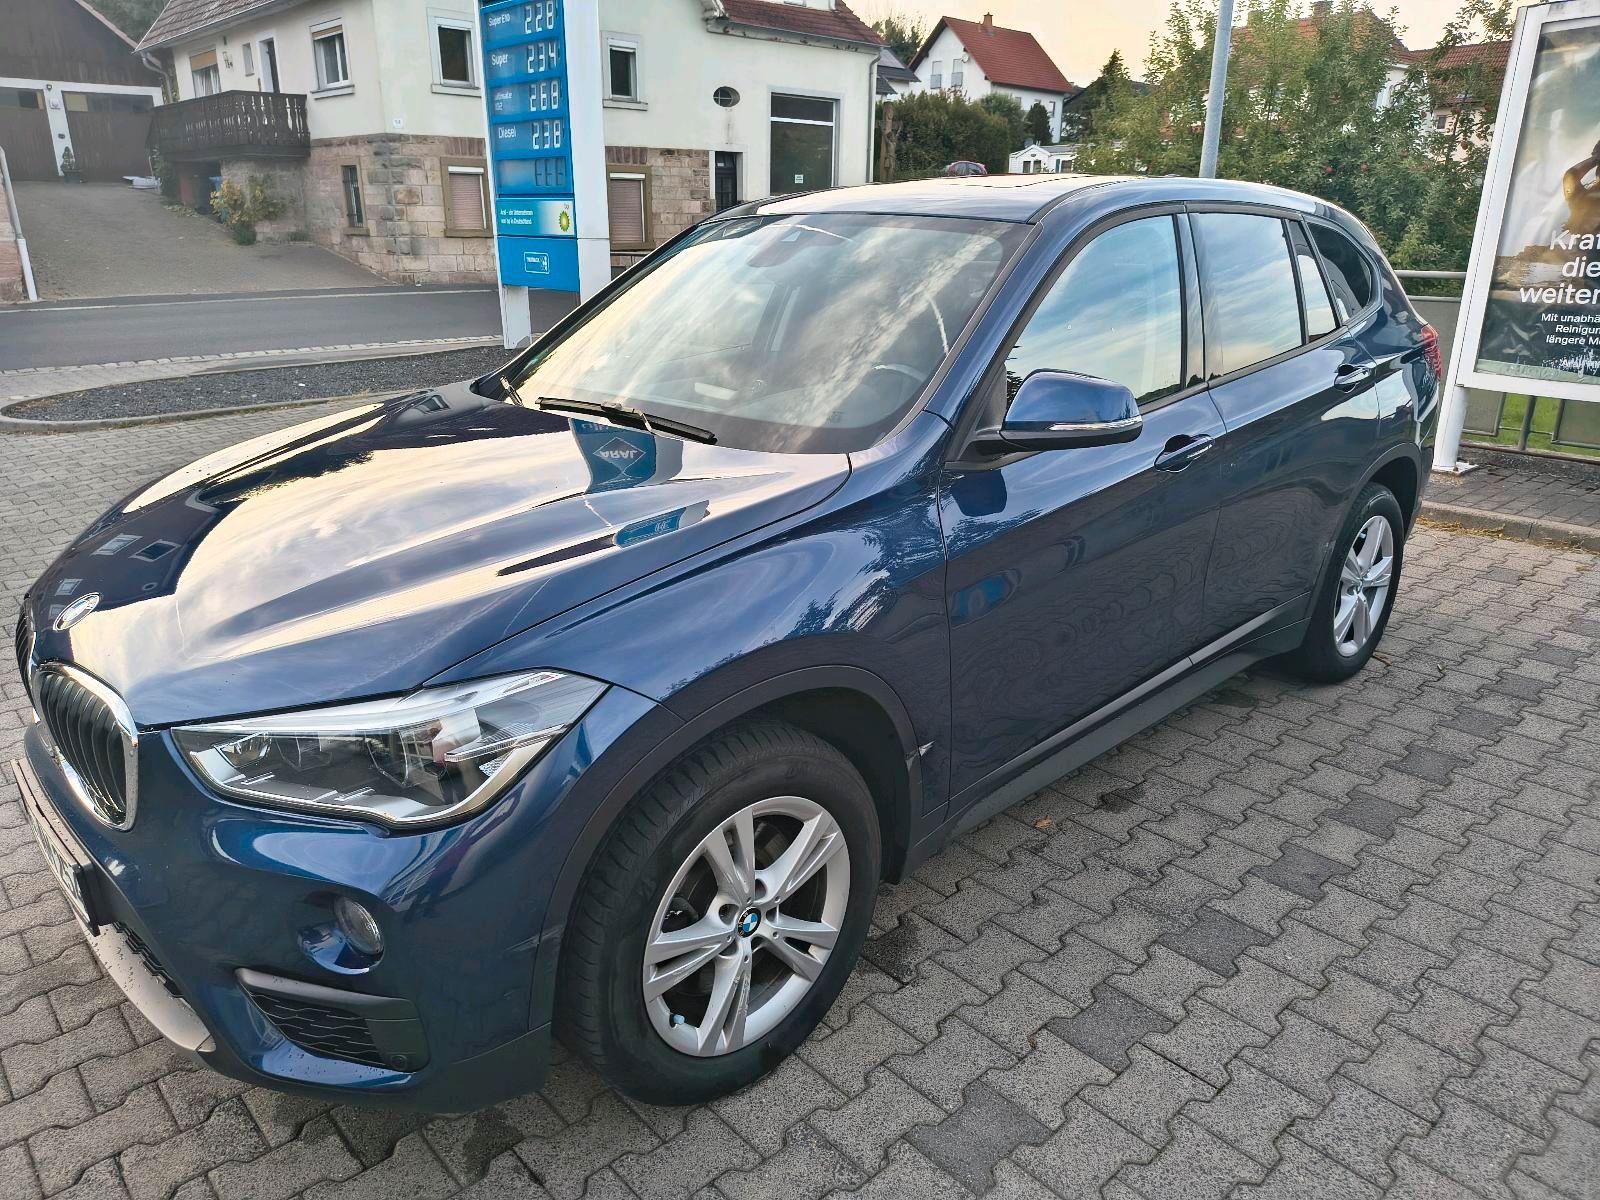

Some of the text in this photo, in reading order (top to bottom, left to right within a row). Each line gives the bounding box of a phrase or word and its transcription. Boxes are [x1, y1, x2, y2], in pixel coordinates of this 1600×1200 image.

[491, 53, 509, 66] Super
[498, 126, 517, 140] Diesel
[1561, 256, 1600, 278] die
[1541, 313, 1558, 322] Mit
[1546, 334, 1586, 346] längere
